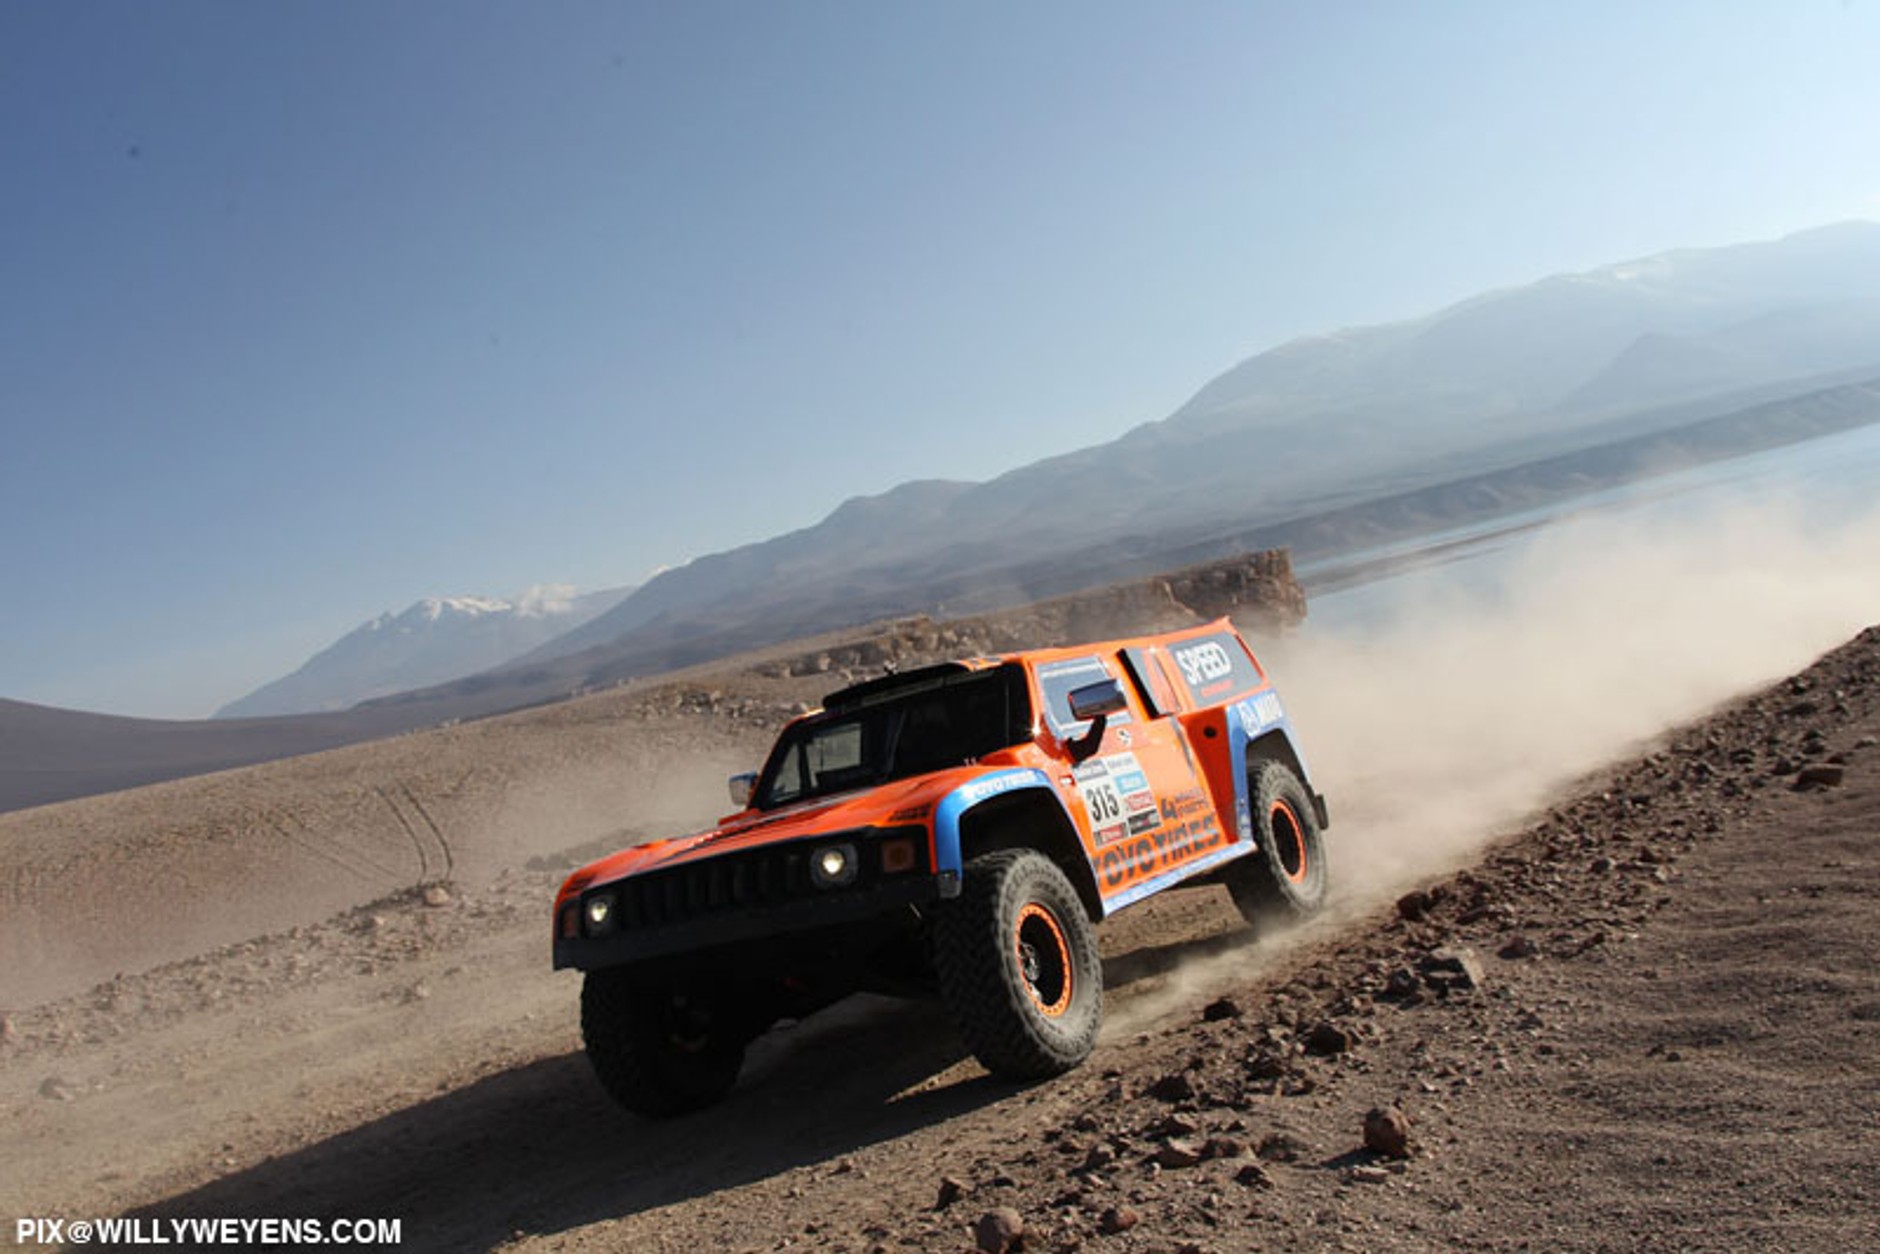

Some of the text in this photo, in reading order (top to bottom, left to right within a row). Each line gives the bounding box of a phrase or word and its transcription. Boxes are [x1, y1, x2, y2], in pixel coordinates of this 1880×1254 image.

[1176, 641, 1230, 685] SPEED
[1086, 784, 1119, 822] 315
[1154, 814, 1220, 864] TIRES
